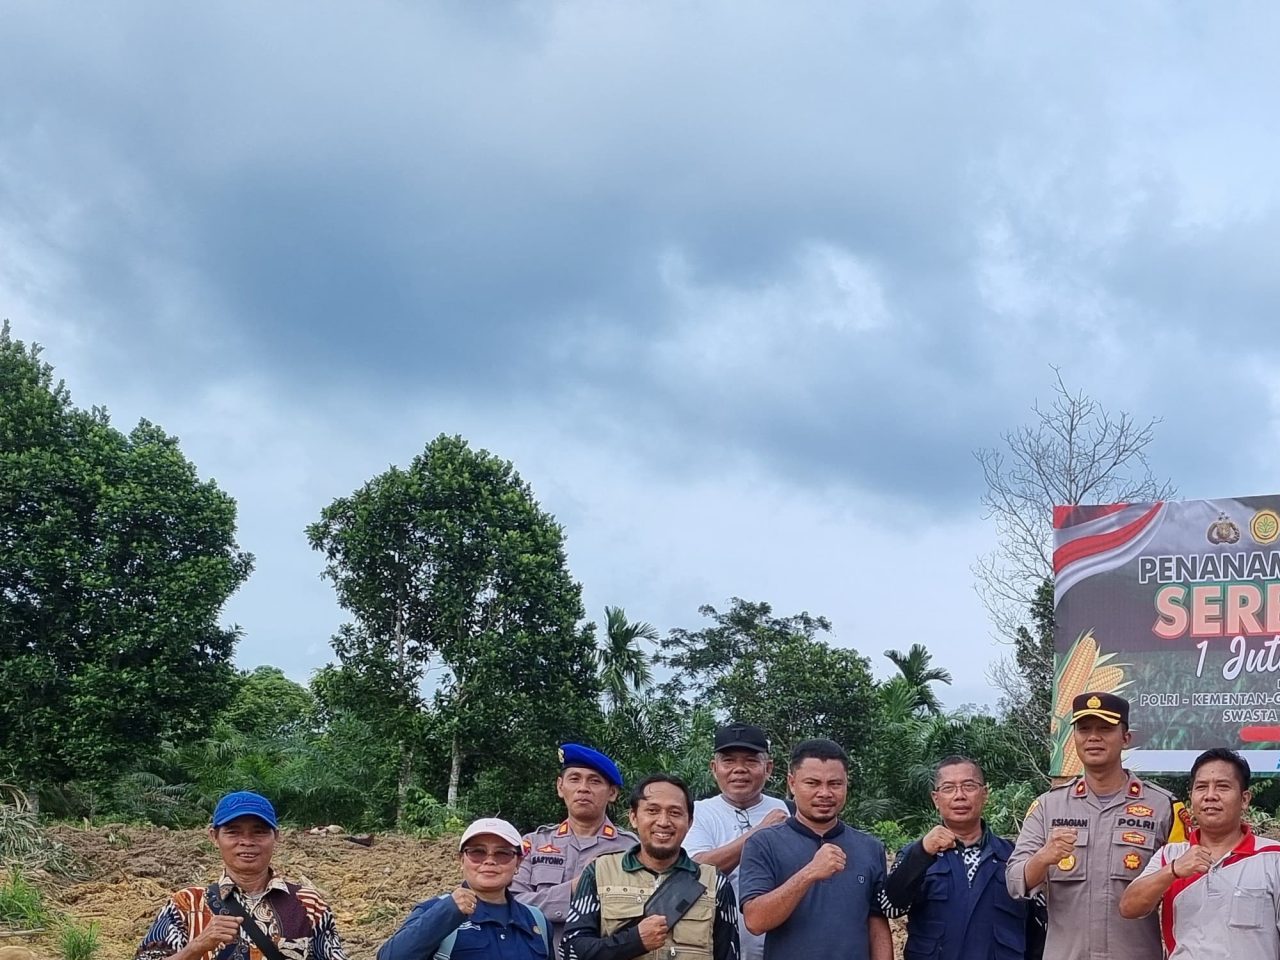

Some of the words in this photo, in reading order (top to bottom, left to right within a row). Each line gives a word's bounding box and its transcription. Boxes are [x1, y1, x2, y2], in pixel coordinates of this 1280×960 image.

[1196, 640, 1209, 678] 1
[1140, 693, 1179, 707] POLRI
[1222, 709, 1277, 722] SWASTA
[1118, 817, 1155, 830] POLRI
